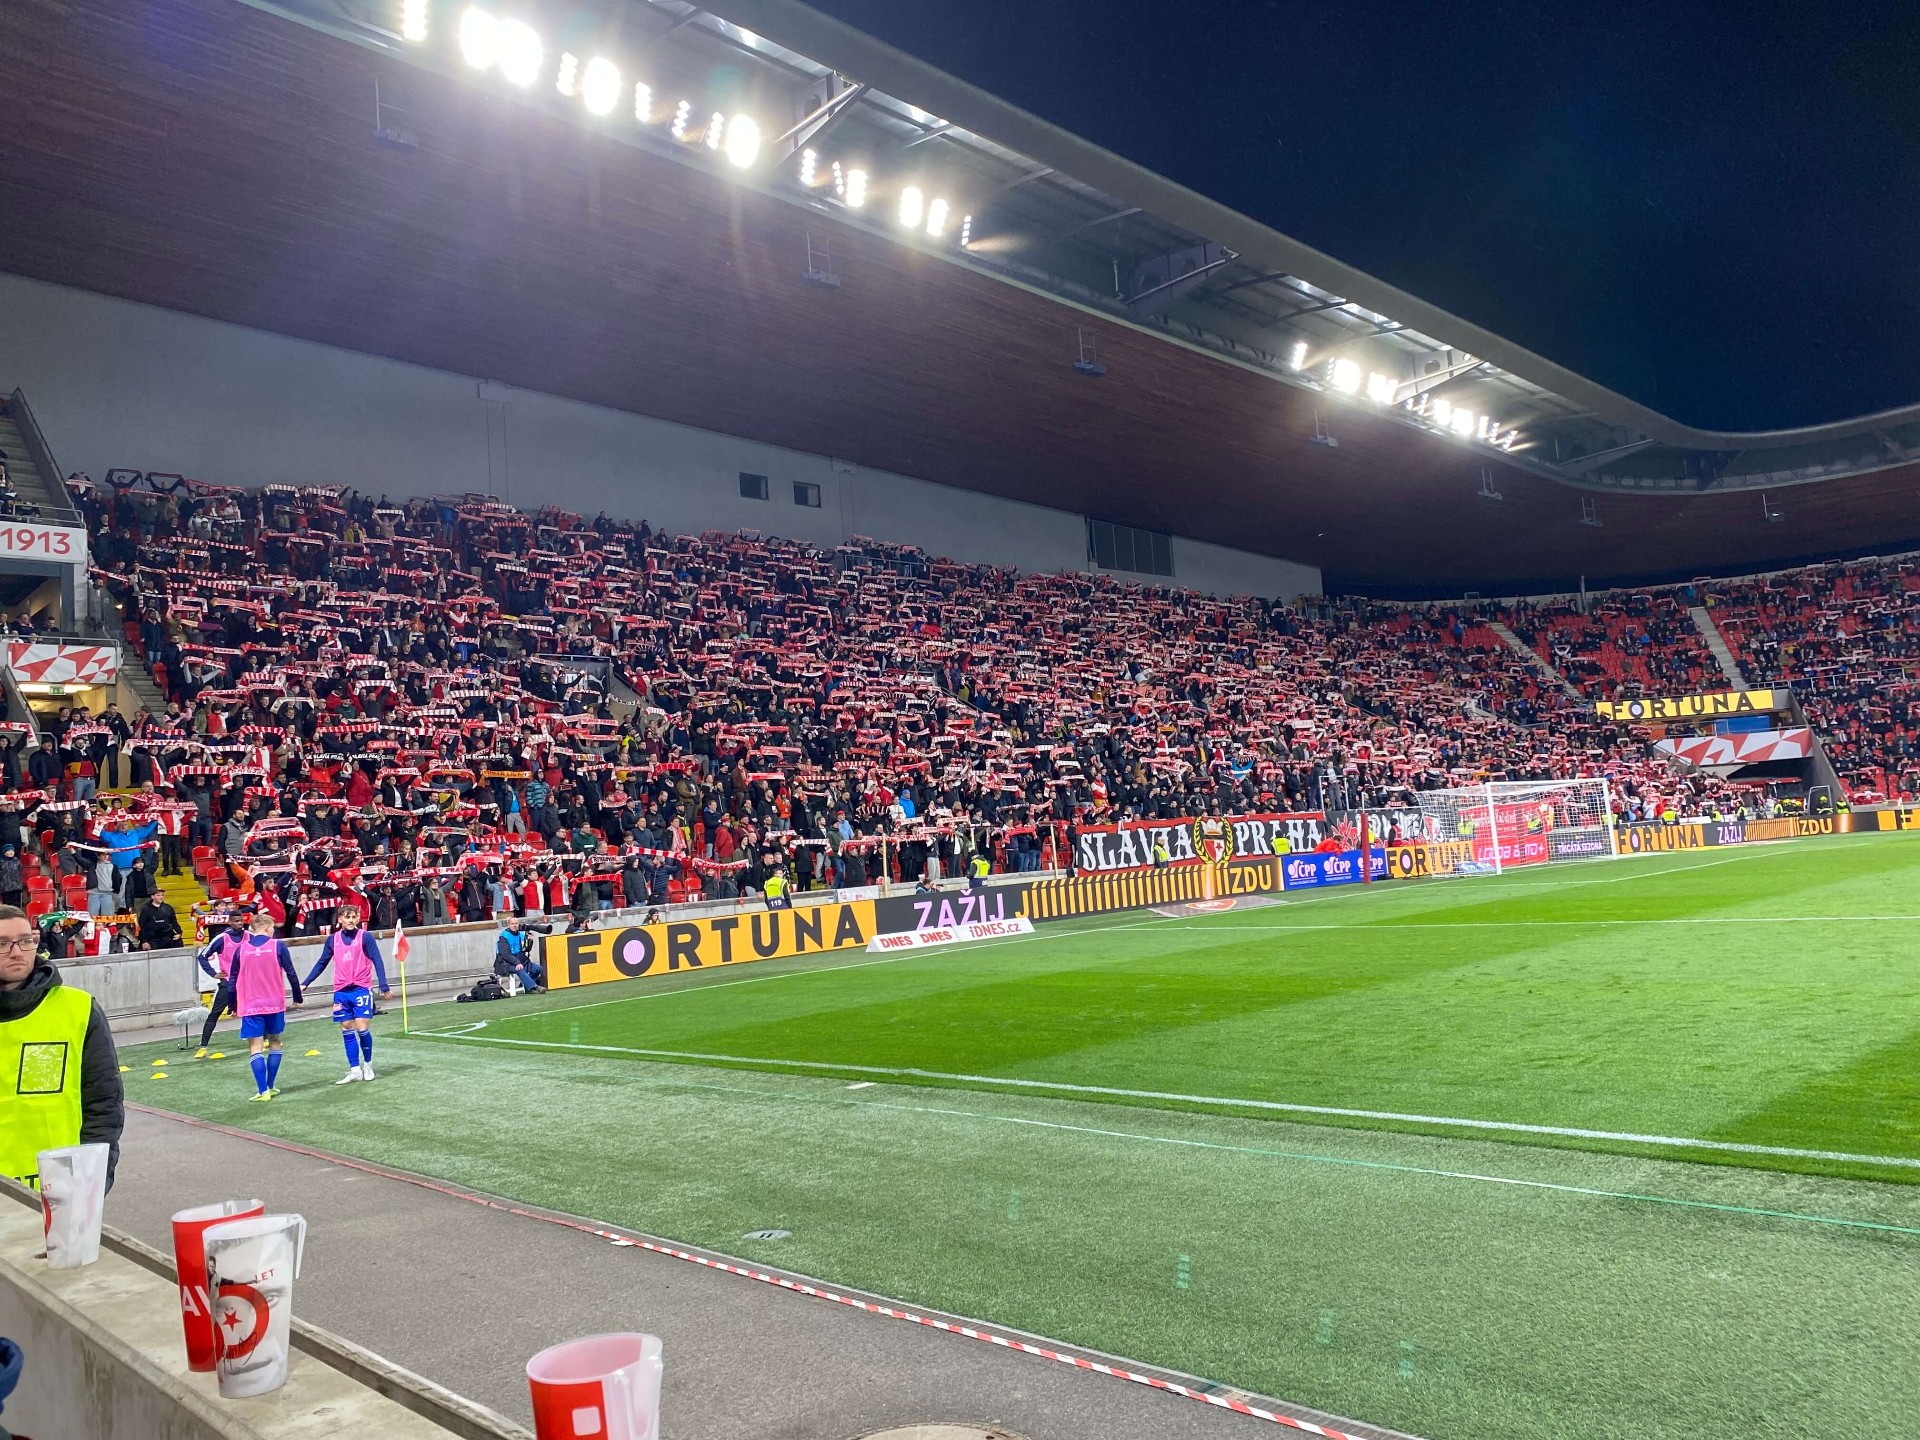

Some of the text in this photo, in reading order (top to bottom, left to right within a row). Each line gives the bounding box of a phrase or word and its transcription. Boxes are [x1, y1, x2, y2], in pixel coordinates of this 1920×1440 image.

[1, 527, 71, 554] 1913
[1612, 691, 1755, 720] FORTUNA
[106, 812, 160, 822] SLAVIA
[1081, 823, 1197, 872] SLAVIA
[1618, 824, 1699, 854] FORTUNA
[1717, 821, 1742, 844] ZAŽIJ
[1299, 861, 1317, 877] ČPP
[1334, 857, 1351, 874] ČPP
[1387, 843, 1472, 878] FORTUNA
[770, 900, 782, 908] 119
[914, 888, 1005, 931] ZAŽIJ
[567, 904, 864, 984] FORTUNA
[879, 922, 1022, 949] DNES DNES iDNES.cz
[356, 994, 370, 1007] 37
[255, 1269, 275, 1284] LET
